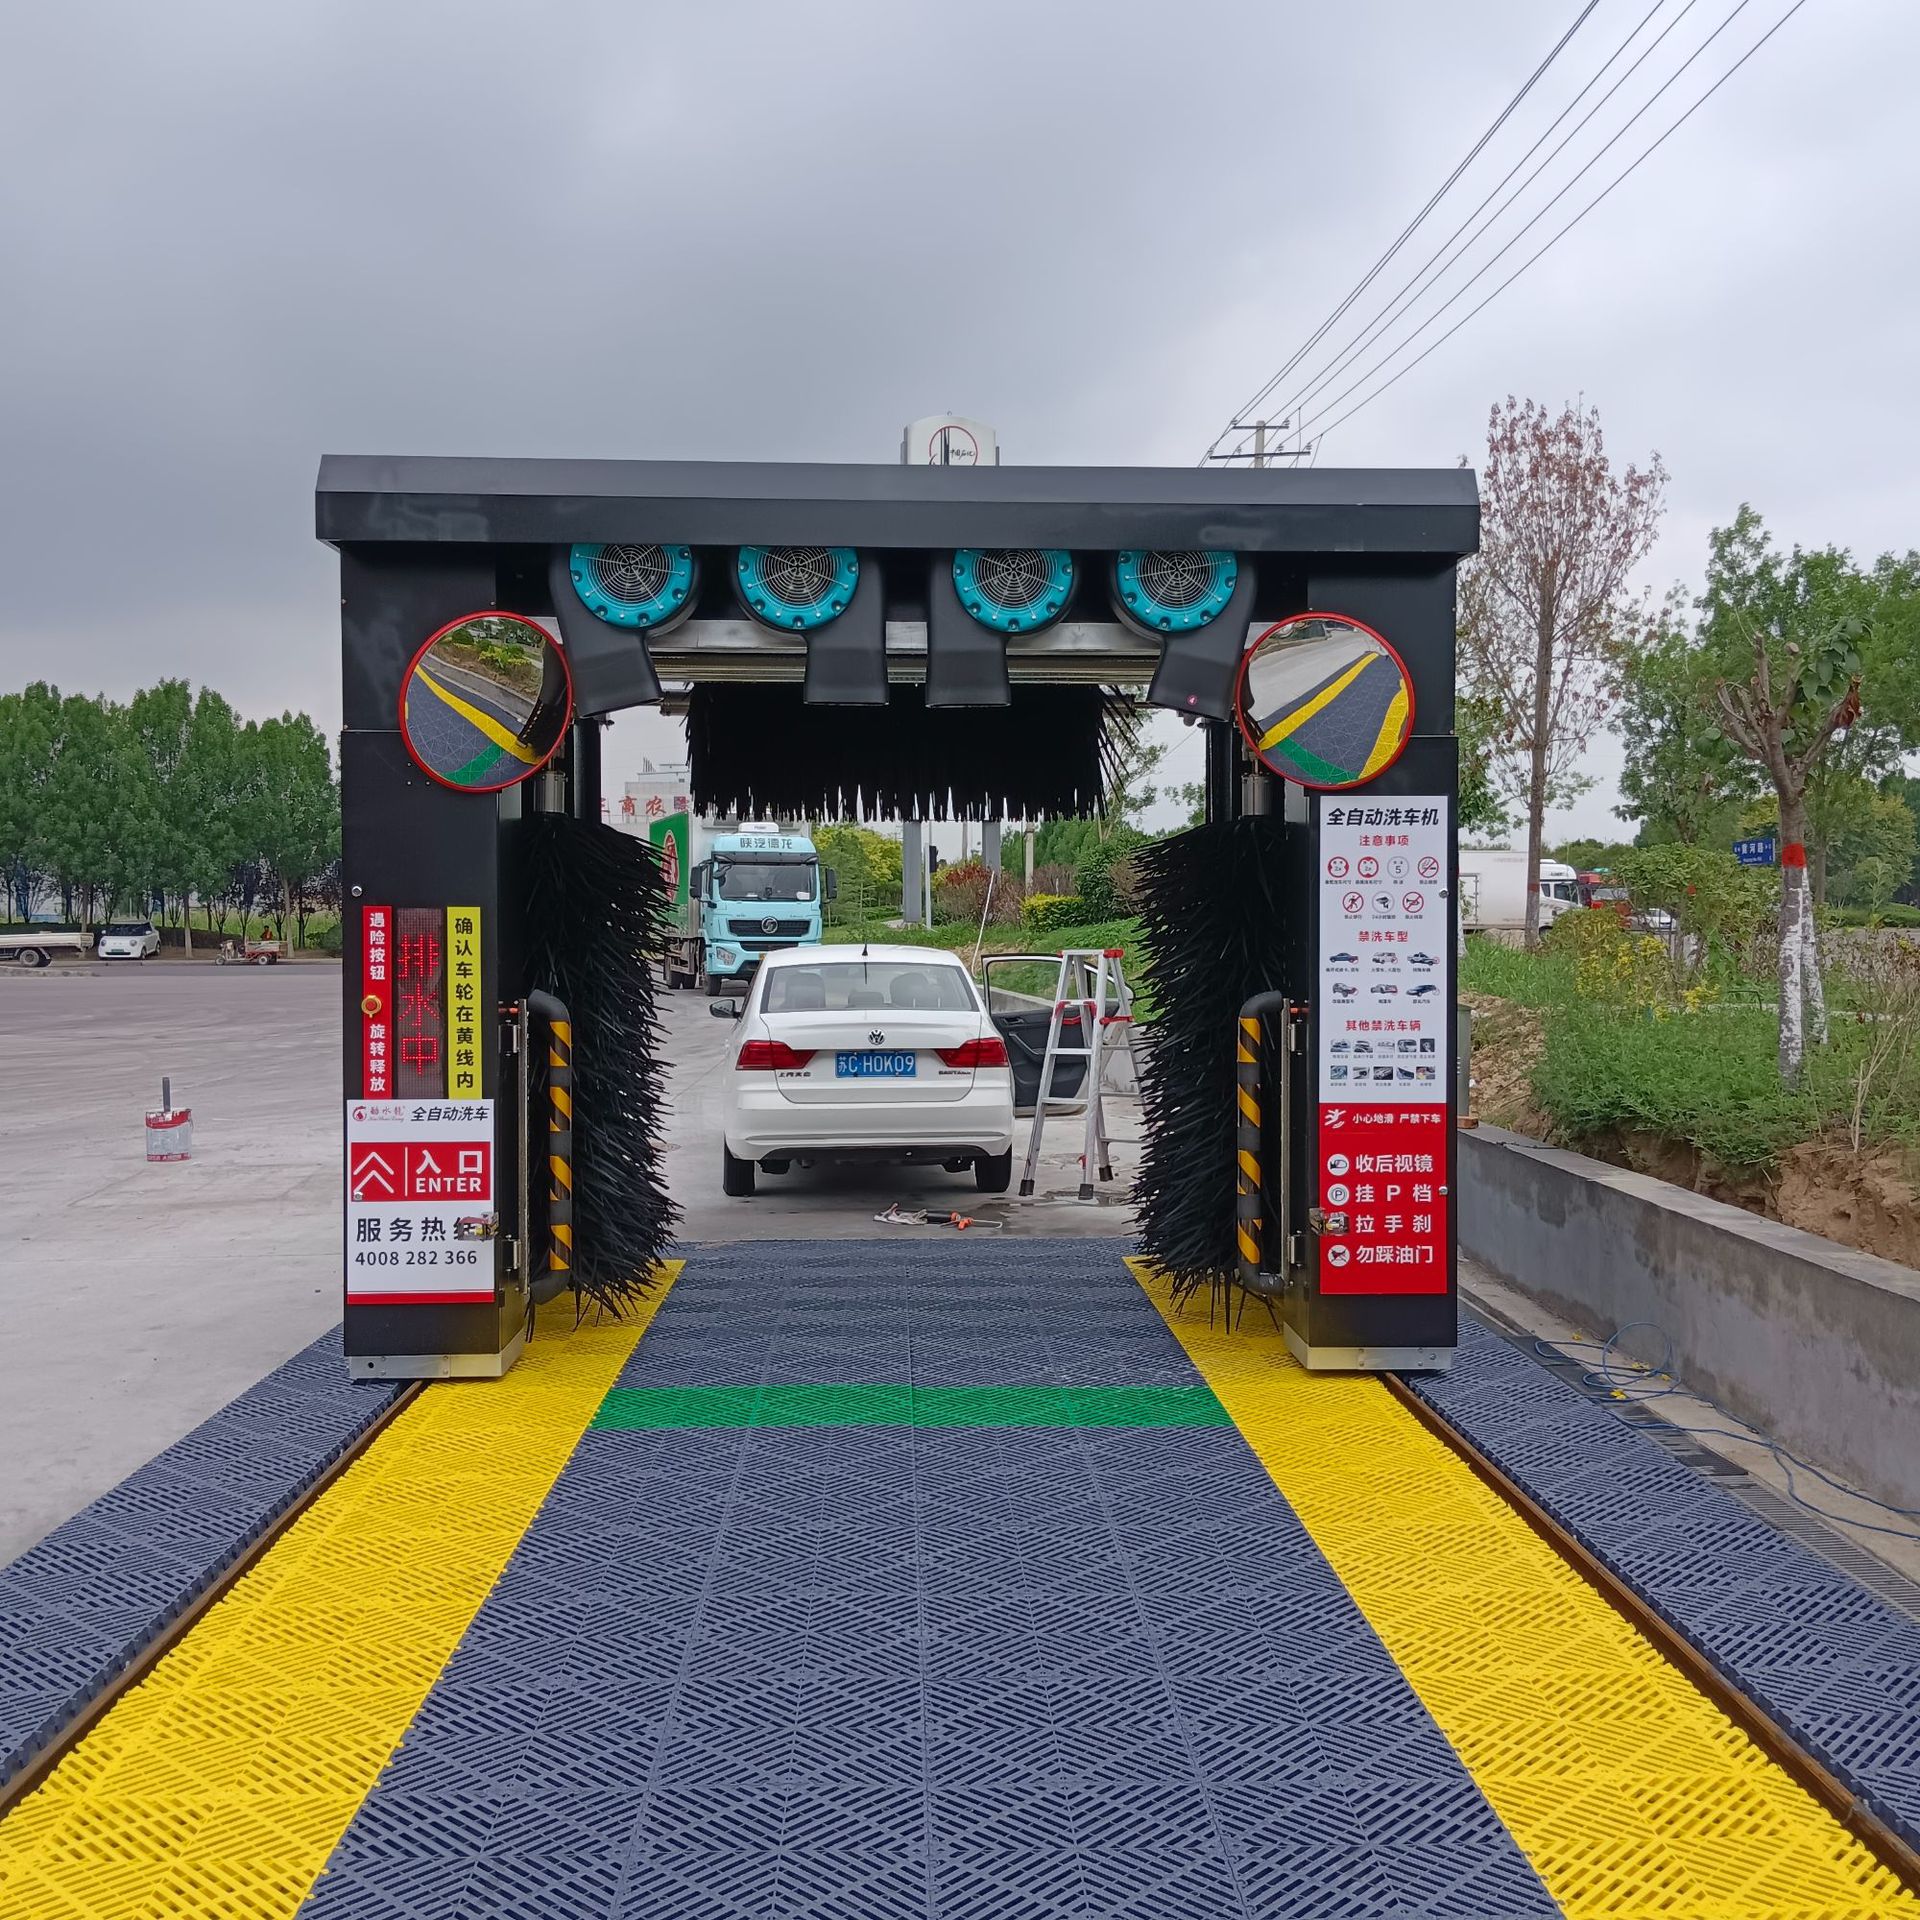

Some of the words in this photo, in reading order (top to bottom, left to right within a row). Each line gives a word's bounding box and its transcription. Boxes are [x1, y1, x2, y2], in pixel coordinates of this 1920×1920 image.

[1327, 808, 1439, 826] 全自动洗车机
[740, 837, 793, 849] 陕汽德龙
[1359, 835, 1409, 846] 注意事项
[1358, 931, 1408, 942] 禁洗车型
[369, 912, 385, 980] 遇险按钮
[398, 934, 440, 1076] 排水中
[454, 917, 474, 1088] 确认车轮在黄线内
[1346, 1020, 1421, 1032] 其他禁洗车辆
[369, 1024, 385, 1092] 旋转释放
[410, 1106, 489, 1122] 全自动洗车
[1352, 1113, 1394, 1124] 小心地滑
[1399, 1113, 1441, 1124] 严禁下车
[415, 1149, 483, 1175] 入口
[1355, 1154, 1433, 1173] 收后视镜
[415, 1177, 482, 1193] ENTER
[1355, 1214, 1432, 1234] 拉手刹
[355, 1252, 400, 1266] 4008
[406, 1251, 438, 1265] 282
[444, 1250, 477, 1264] 366
[1356, 1245, 1433, 1264] 勿踩油门
